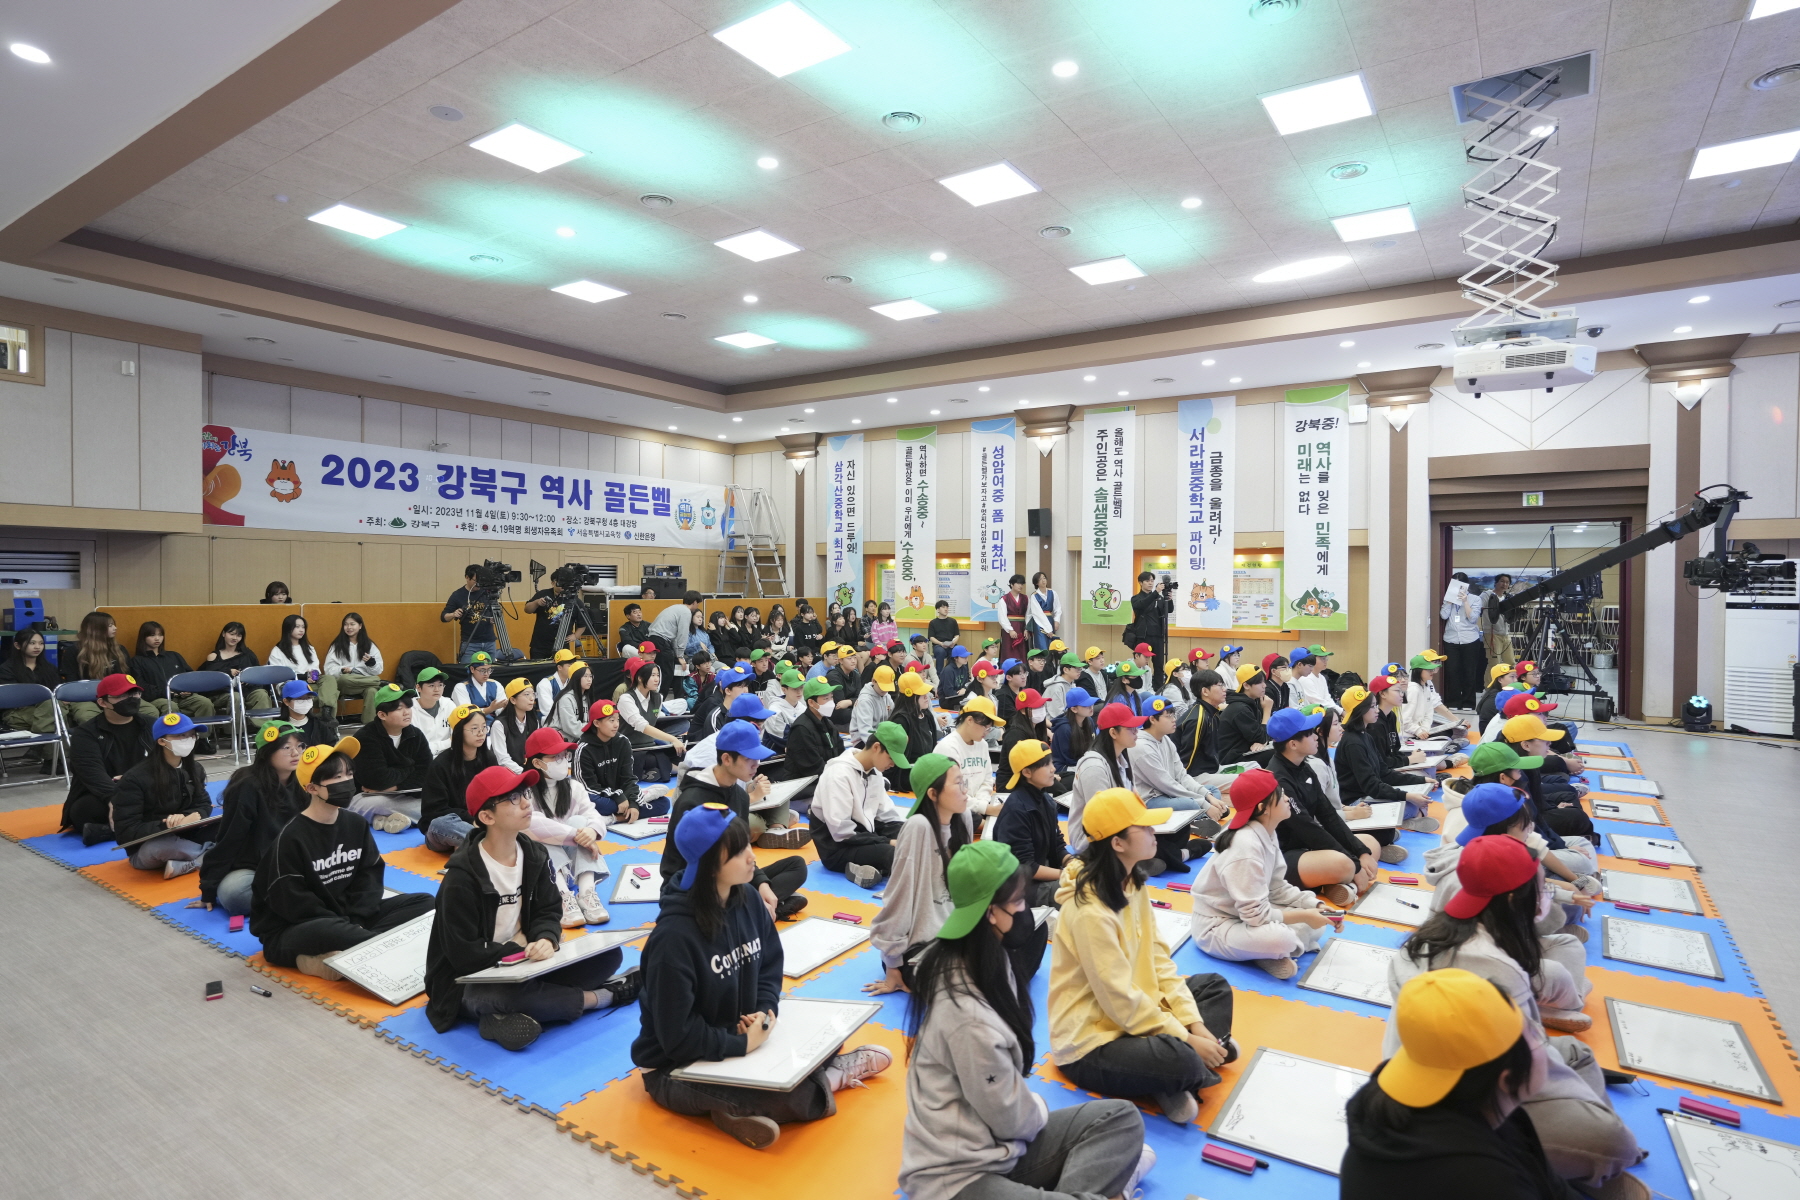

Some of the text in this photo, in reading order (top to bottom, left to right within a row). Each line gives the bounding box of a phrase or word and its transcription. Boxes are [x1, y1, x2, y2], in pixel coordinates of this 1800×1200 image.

[1296, 417, 1339, 433] 강북중!
[220, 434, 252, 462] 강북
[919, 444, 927, 477] 역사하면
[320, 454, 672, 516] 2023 강북구 역사 골든벨
[1112, 428, 1124, 518] 올해도 역사 골든벨의
[1210, 451, 1224, 492] 금종을
[1297, 442, 1312, 516] 미래는 없다
[846, 460, 858, 554] 자신 있으면 드루와!
[904, 488, 912, 504] 이미
[992, 445, 1006, 572] 성암여중 폼 미쳤다!
[1092, 429, 1110, 570] 주인공은 솔샘중학교!
[1188, 427, 1205, 570] 서라벌중학교 파이팅!
[1315, 442, 1332, 576] 역사를 잊은 민족에게
[366, 516, 386, 527] 주최:
[410, 520, 440, 529] 강북구
[412, 504, 556, 523] 일시: 2023년 11월 4일(토) 9:30~12:00
[460, 522, 563, 536] 후원: 4.19혁명 희생자유족회
[566, 516, 638, 529] 장소: 강북구청 4층 대강당
[834, 460, 844, 573] 삼각산중학교 최고!!!
[904, 506, 912, 538] 우리에게
[576, 528, 621, 538] 서울특별시교육청
[634, 532, 656, 541] 신한은행
[305, 750, 315, 760] 50
